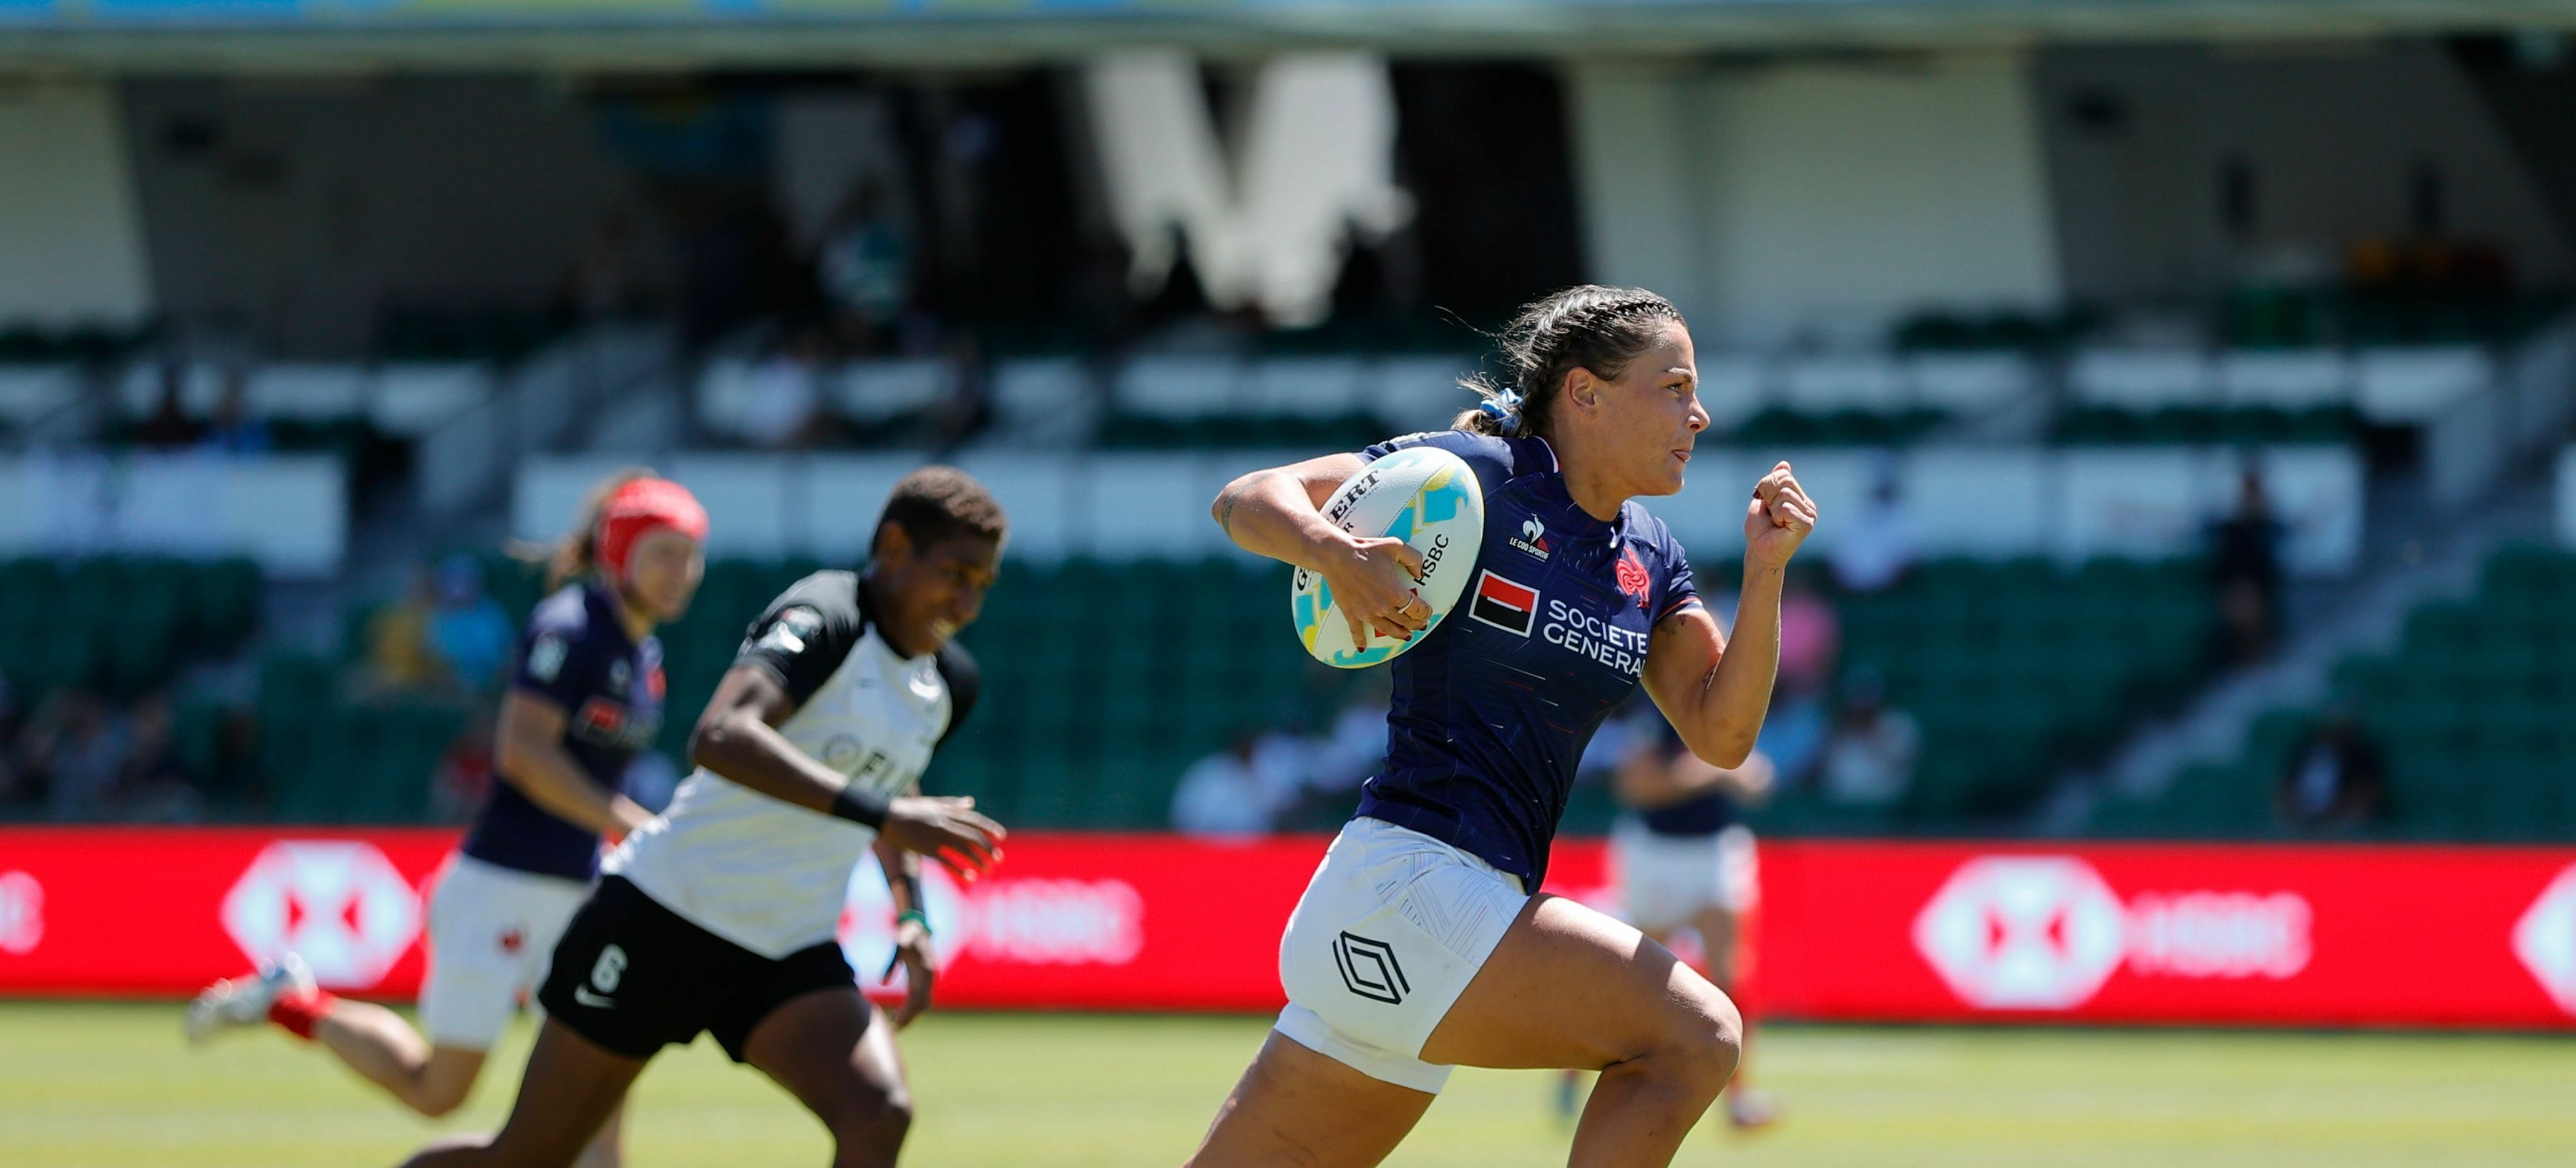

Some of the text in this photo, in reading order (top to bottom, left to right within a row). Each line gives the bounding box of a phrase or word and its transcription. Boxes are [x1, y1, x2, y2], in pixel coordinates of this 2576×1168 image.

[1413, 533, 1449, 586] HSBC
[1509, 537, 1550, 560] LE COQ SPORTIF
[1548, 599, 1647, 655] SOCIETE
[591, 943, 629, 993] 6
